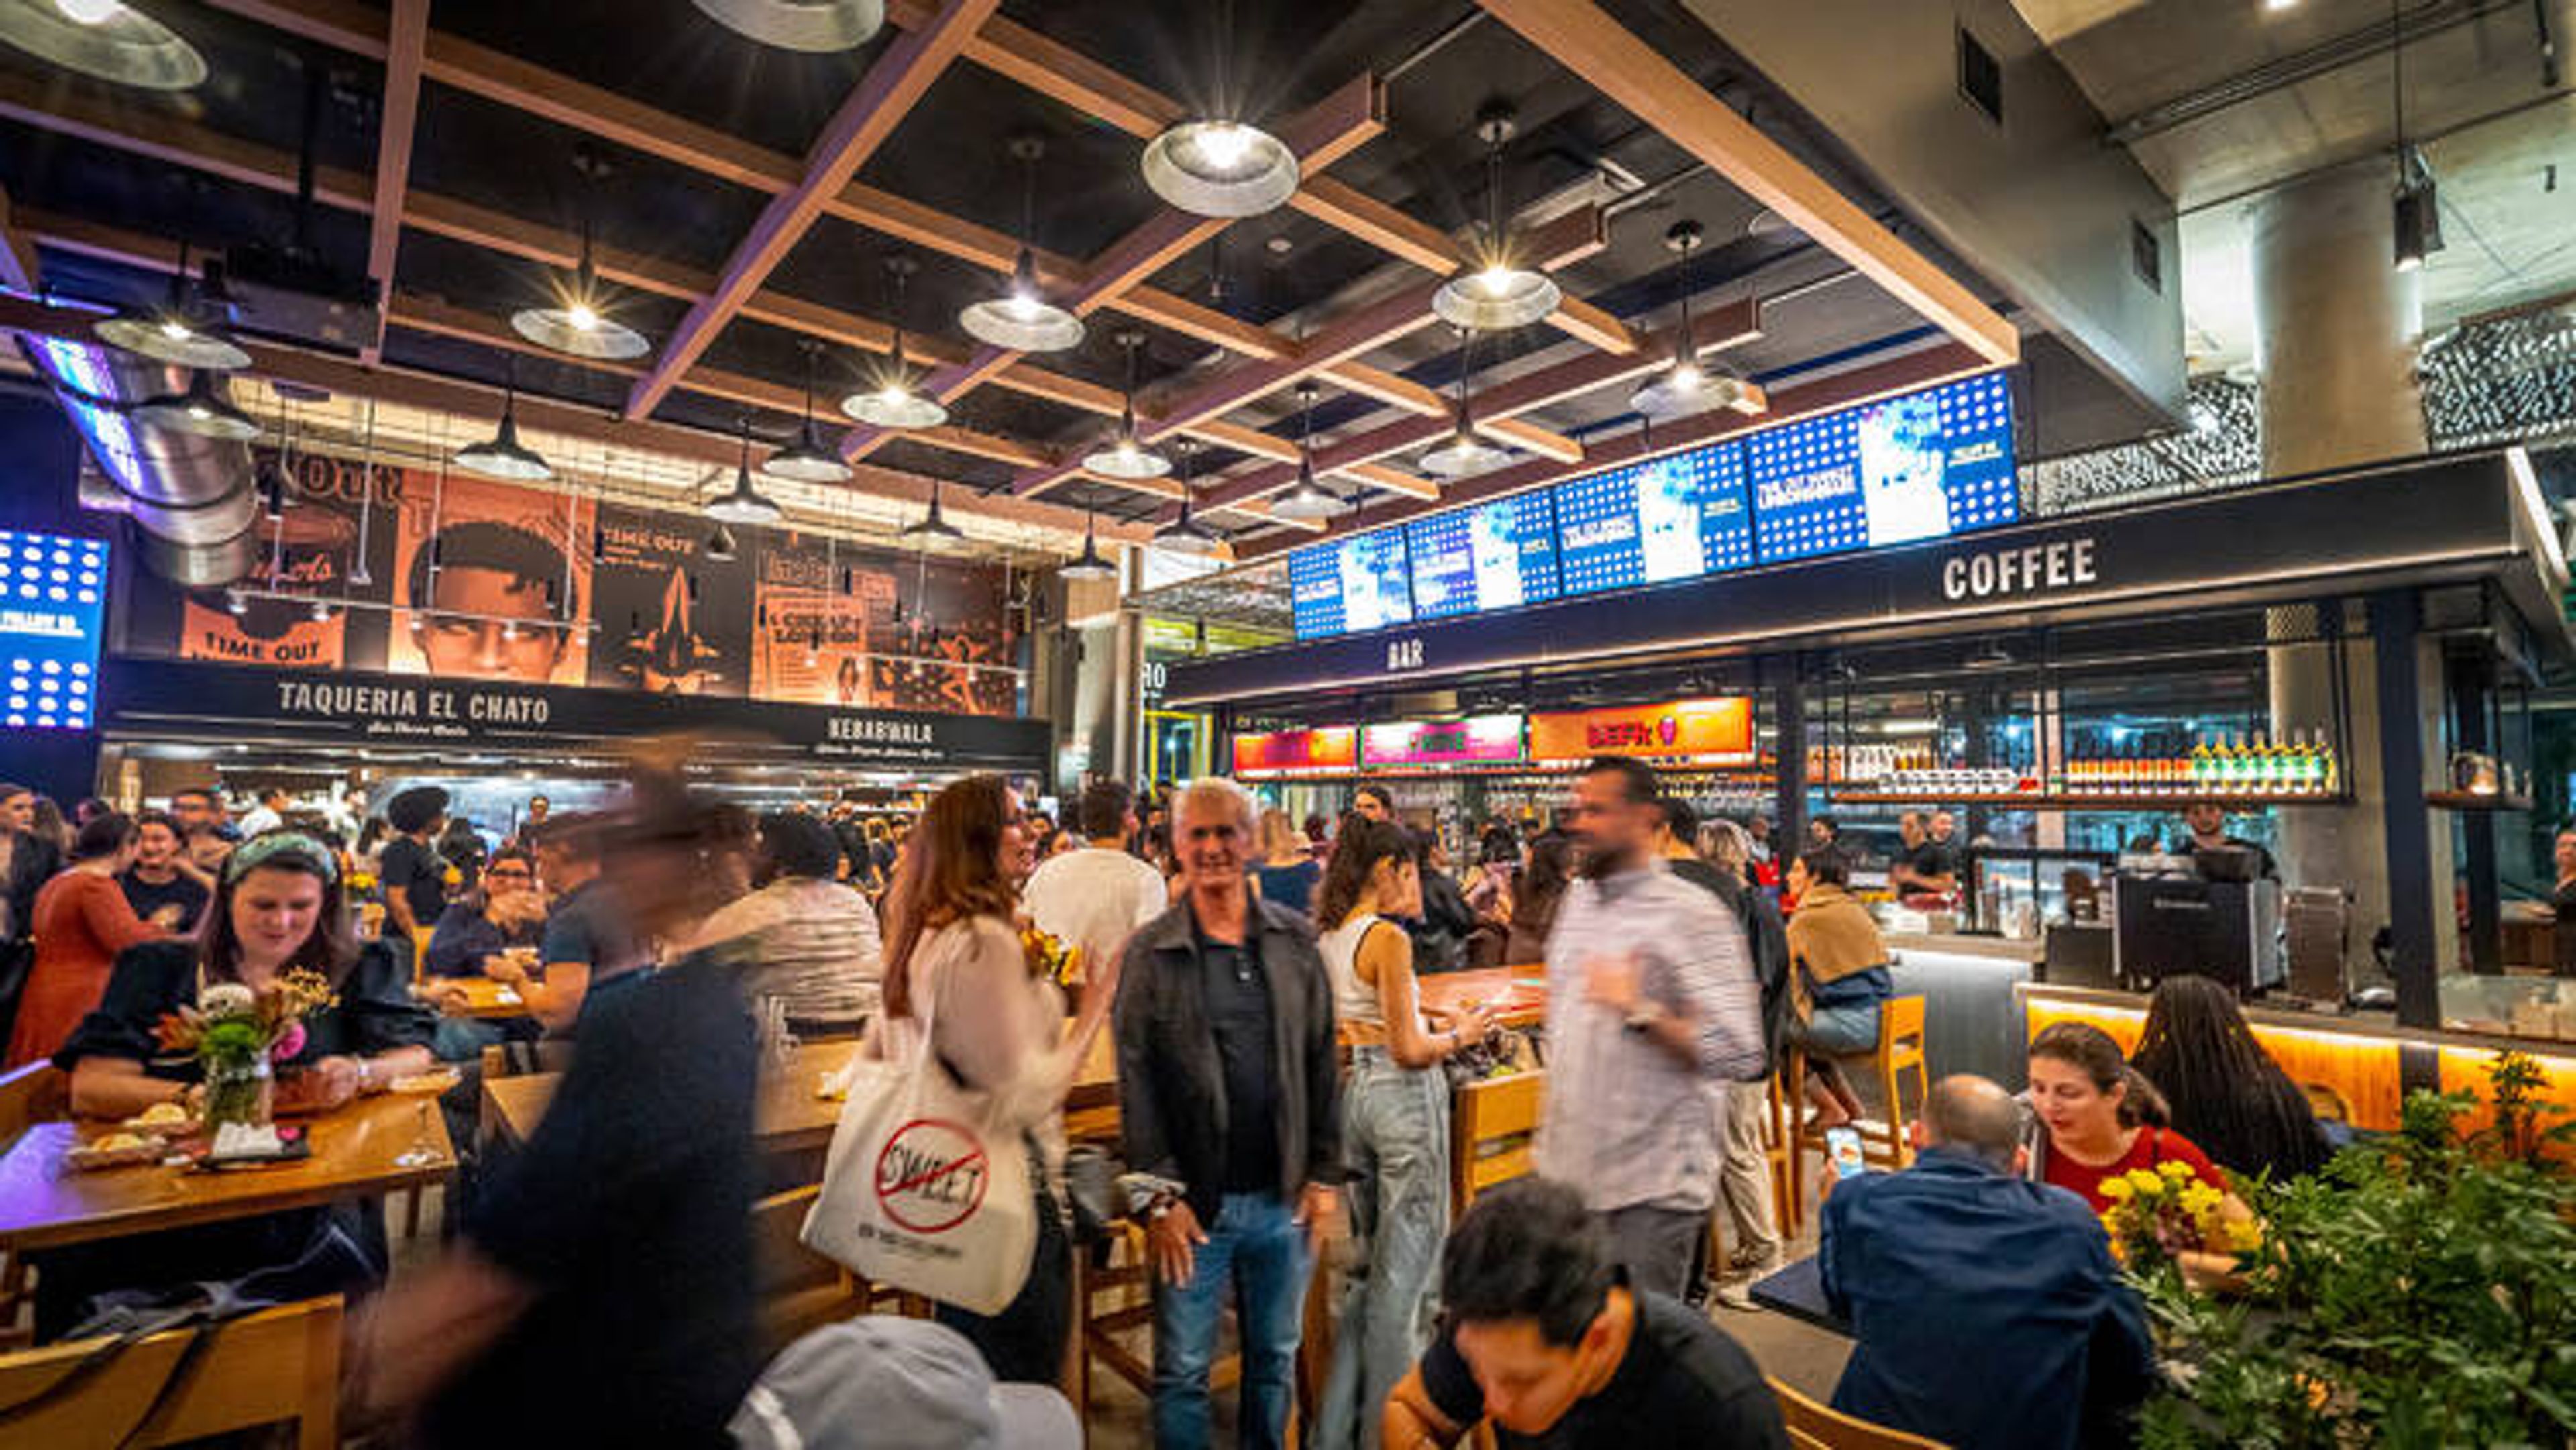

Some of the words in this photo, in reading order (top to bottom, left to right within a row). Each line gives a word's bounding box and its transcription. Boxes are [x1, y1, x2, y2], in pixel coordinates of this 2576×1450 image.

[1943, 538, 2097, 599] COFFEE
[206, 631, 264, 660] TIME
[274, 640, 320, 662] OUT
[1387, 638, 1424, 670] BAR
[278, 682, 417, 716] TAQUERIA
[428, 690, 459, 719] EL
[470, 694, 549, 723] CHATO
